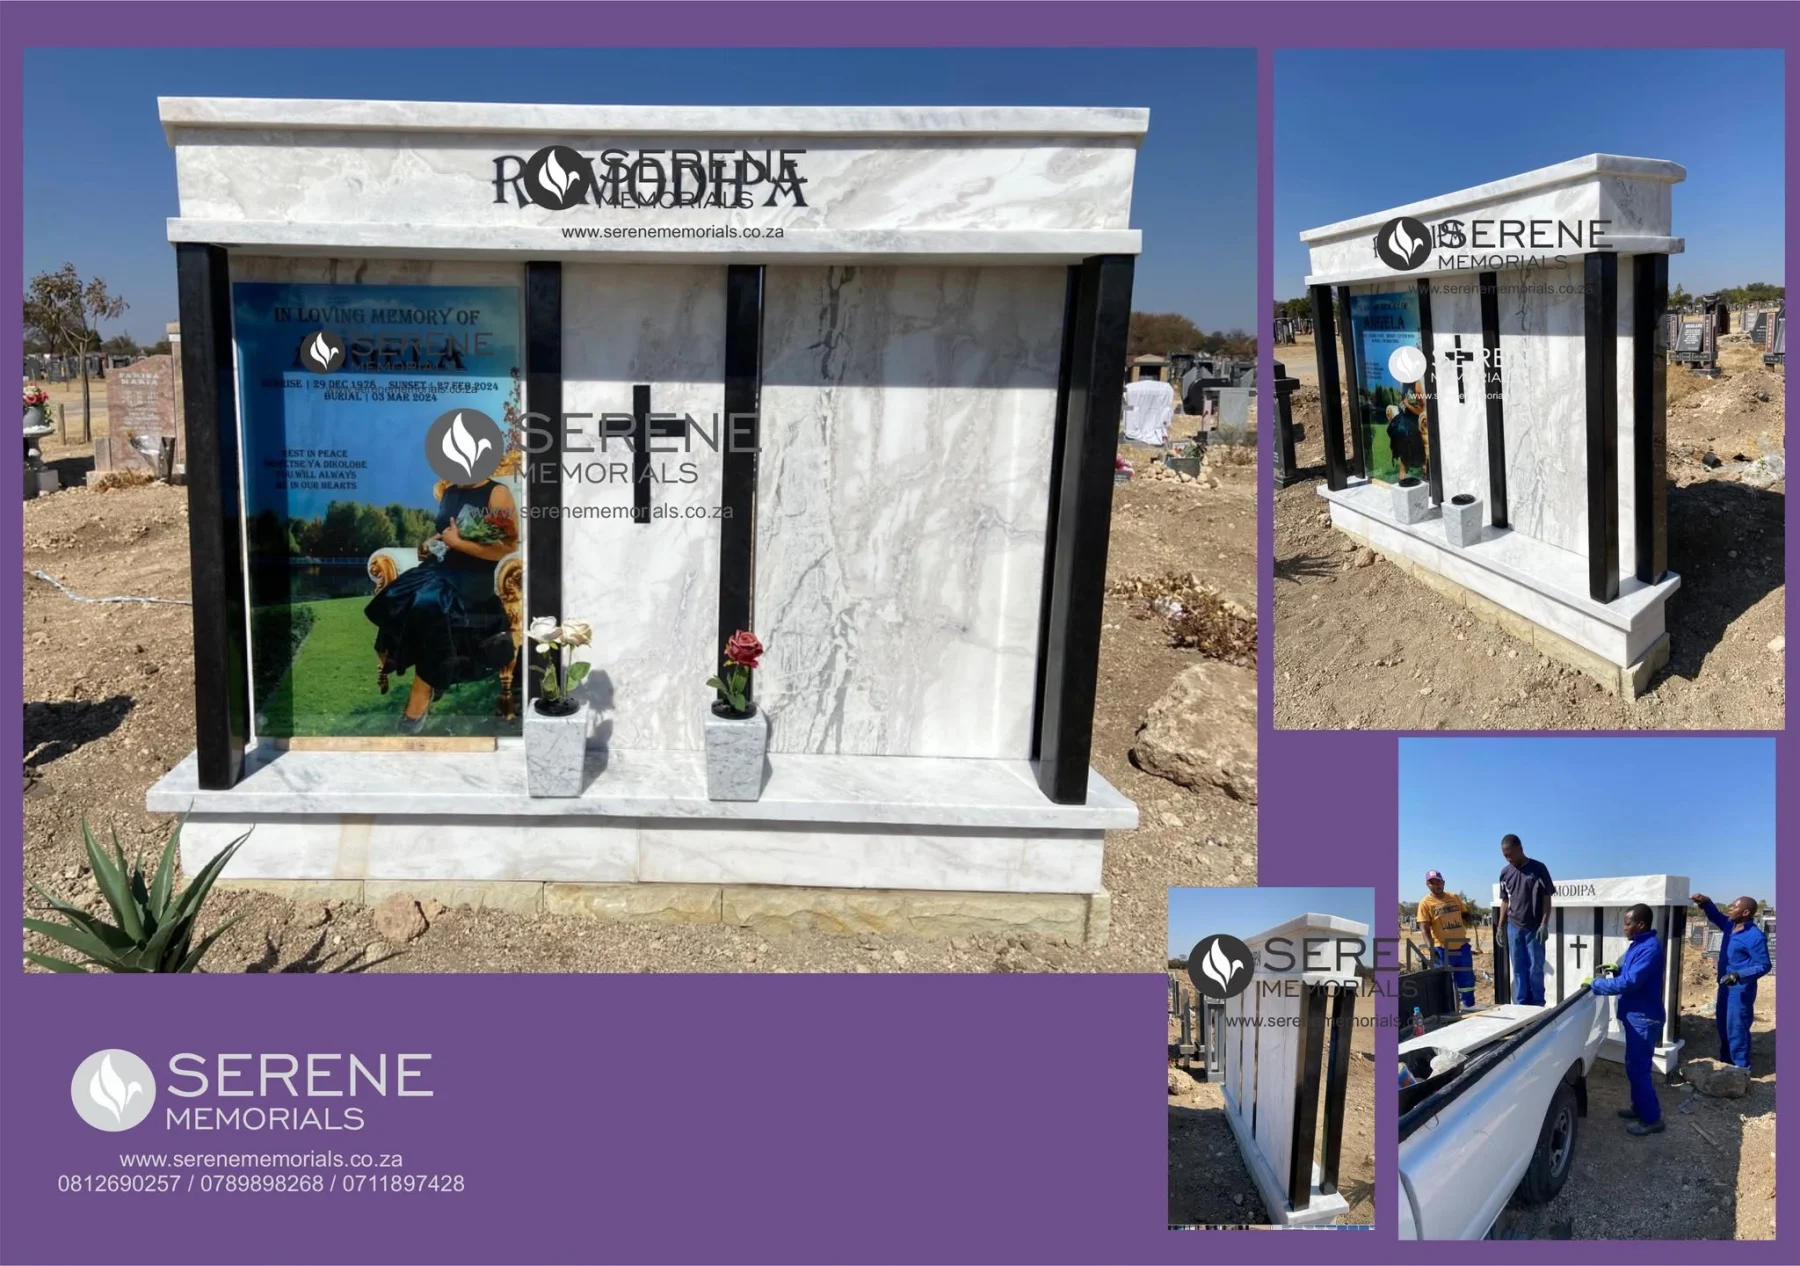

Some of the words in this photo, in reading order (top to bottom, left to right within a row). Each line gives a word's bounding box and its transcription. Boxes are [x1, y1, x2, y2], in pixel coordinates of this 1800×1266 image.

[492, 154, 809, 209] RMODIPA
[274, 307, 292, 323] IN
[298, 307, 365, 324] LOVING
[371, 307, 453, 325] MEMORY
[457, 310, 480, 325] OF
[313, 380, 326, 389] 29
[328, 380, 348, 389] DEC
[389, 381, 427, 389] SUNSET
[437, 381, 450, 390] 27
[452, 382, 471, 390] FEB
[473, 381, 499, 391] 2024
[324, 392, 363, 401] BURIAL
[372, 392, 384, 401] 03
[387, 392, 409, 401] MAR
[412, 392, 438, 402] 2024
[307, 449, 315, 457] IN
[318, 449, 349, 458] PEACE
[308, 460, 320, 468] YA
[324, 460, 368, 469] DIKOLOBE
[295, 470, 317, 479] WILL
[319, 470, 357, 479] ALWAYS
[301, 481, 319, 489] OUR
[321, 481, 357, 490] HEARTS
